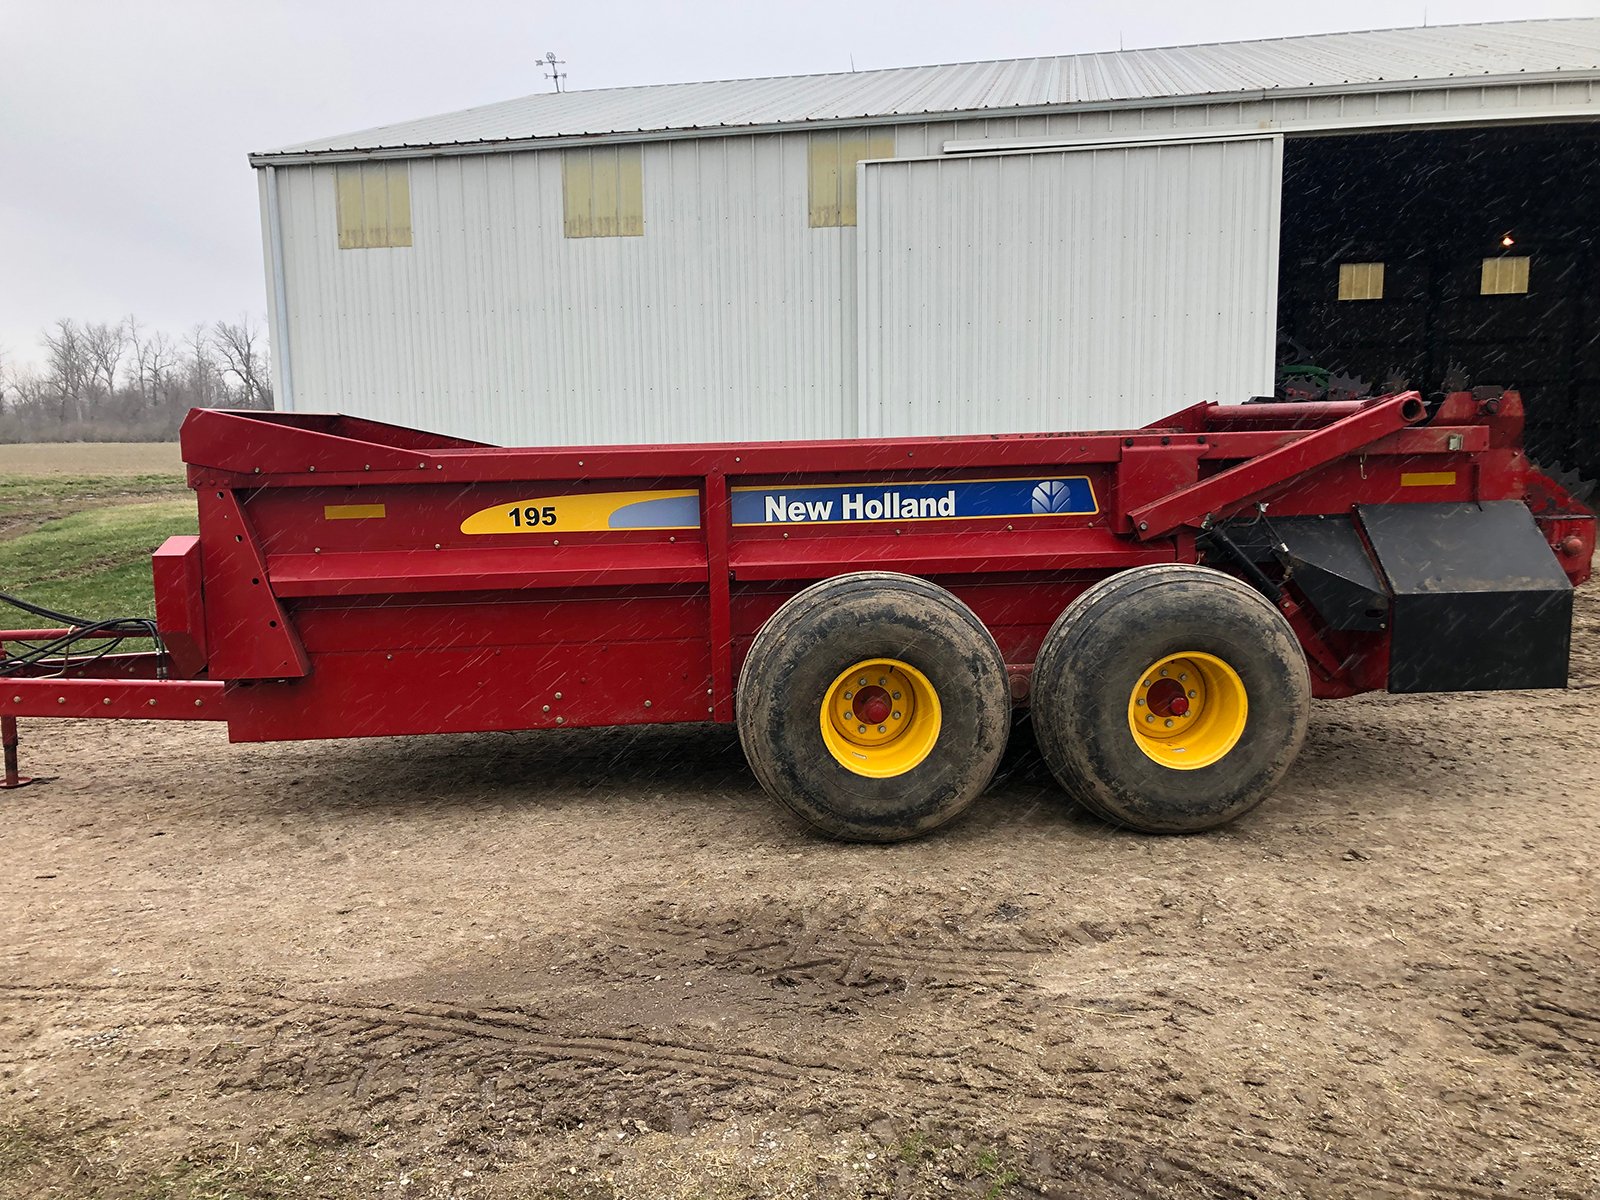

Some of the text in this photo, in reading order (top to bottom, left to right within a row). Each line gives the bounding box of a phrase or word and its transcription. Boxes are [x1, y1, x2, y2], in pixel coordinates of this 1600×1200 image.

[508, 507, 557, 527] 195
[764, 490, 956, 522] New Holland
